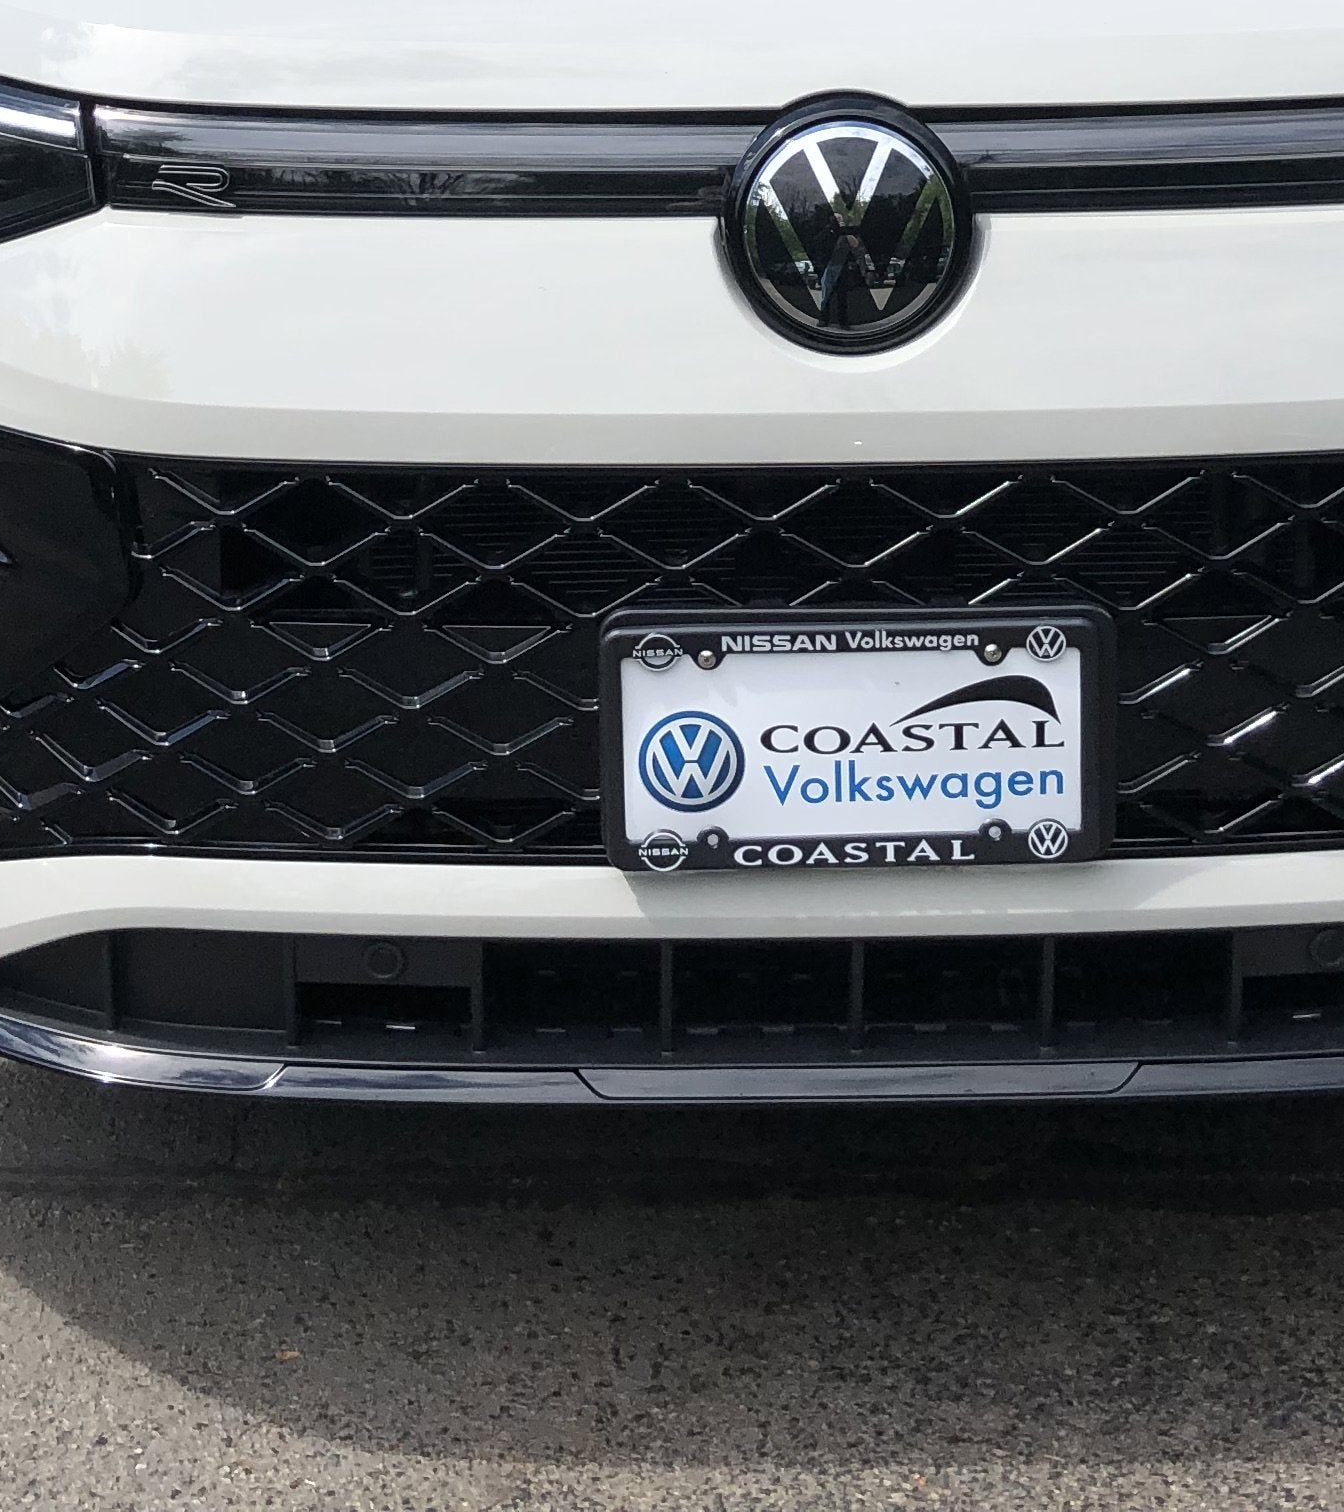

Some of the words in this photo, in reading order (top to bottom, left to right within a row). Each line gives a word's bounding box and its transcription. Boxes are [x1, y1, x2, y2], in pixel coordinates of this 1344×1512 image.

[632, 648, 684, 658] NISSAN
[721, 634, 837, 652] NISSAN
[843, 629, 980, 650] Volkswagen
[759, 718, 1065, 756] COASTAL
[762, 759, 1064, 809] Volkswagen
[638, 846, 689, 856] NISSAN
[733, 838, 976, 867] COASTAL
